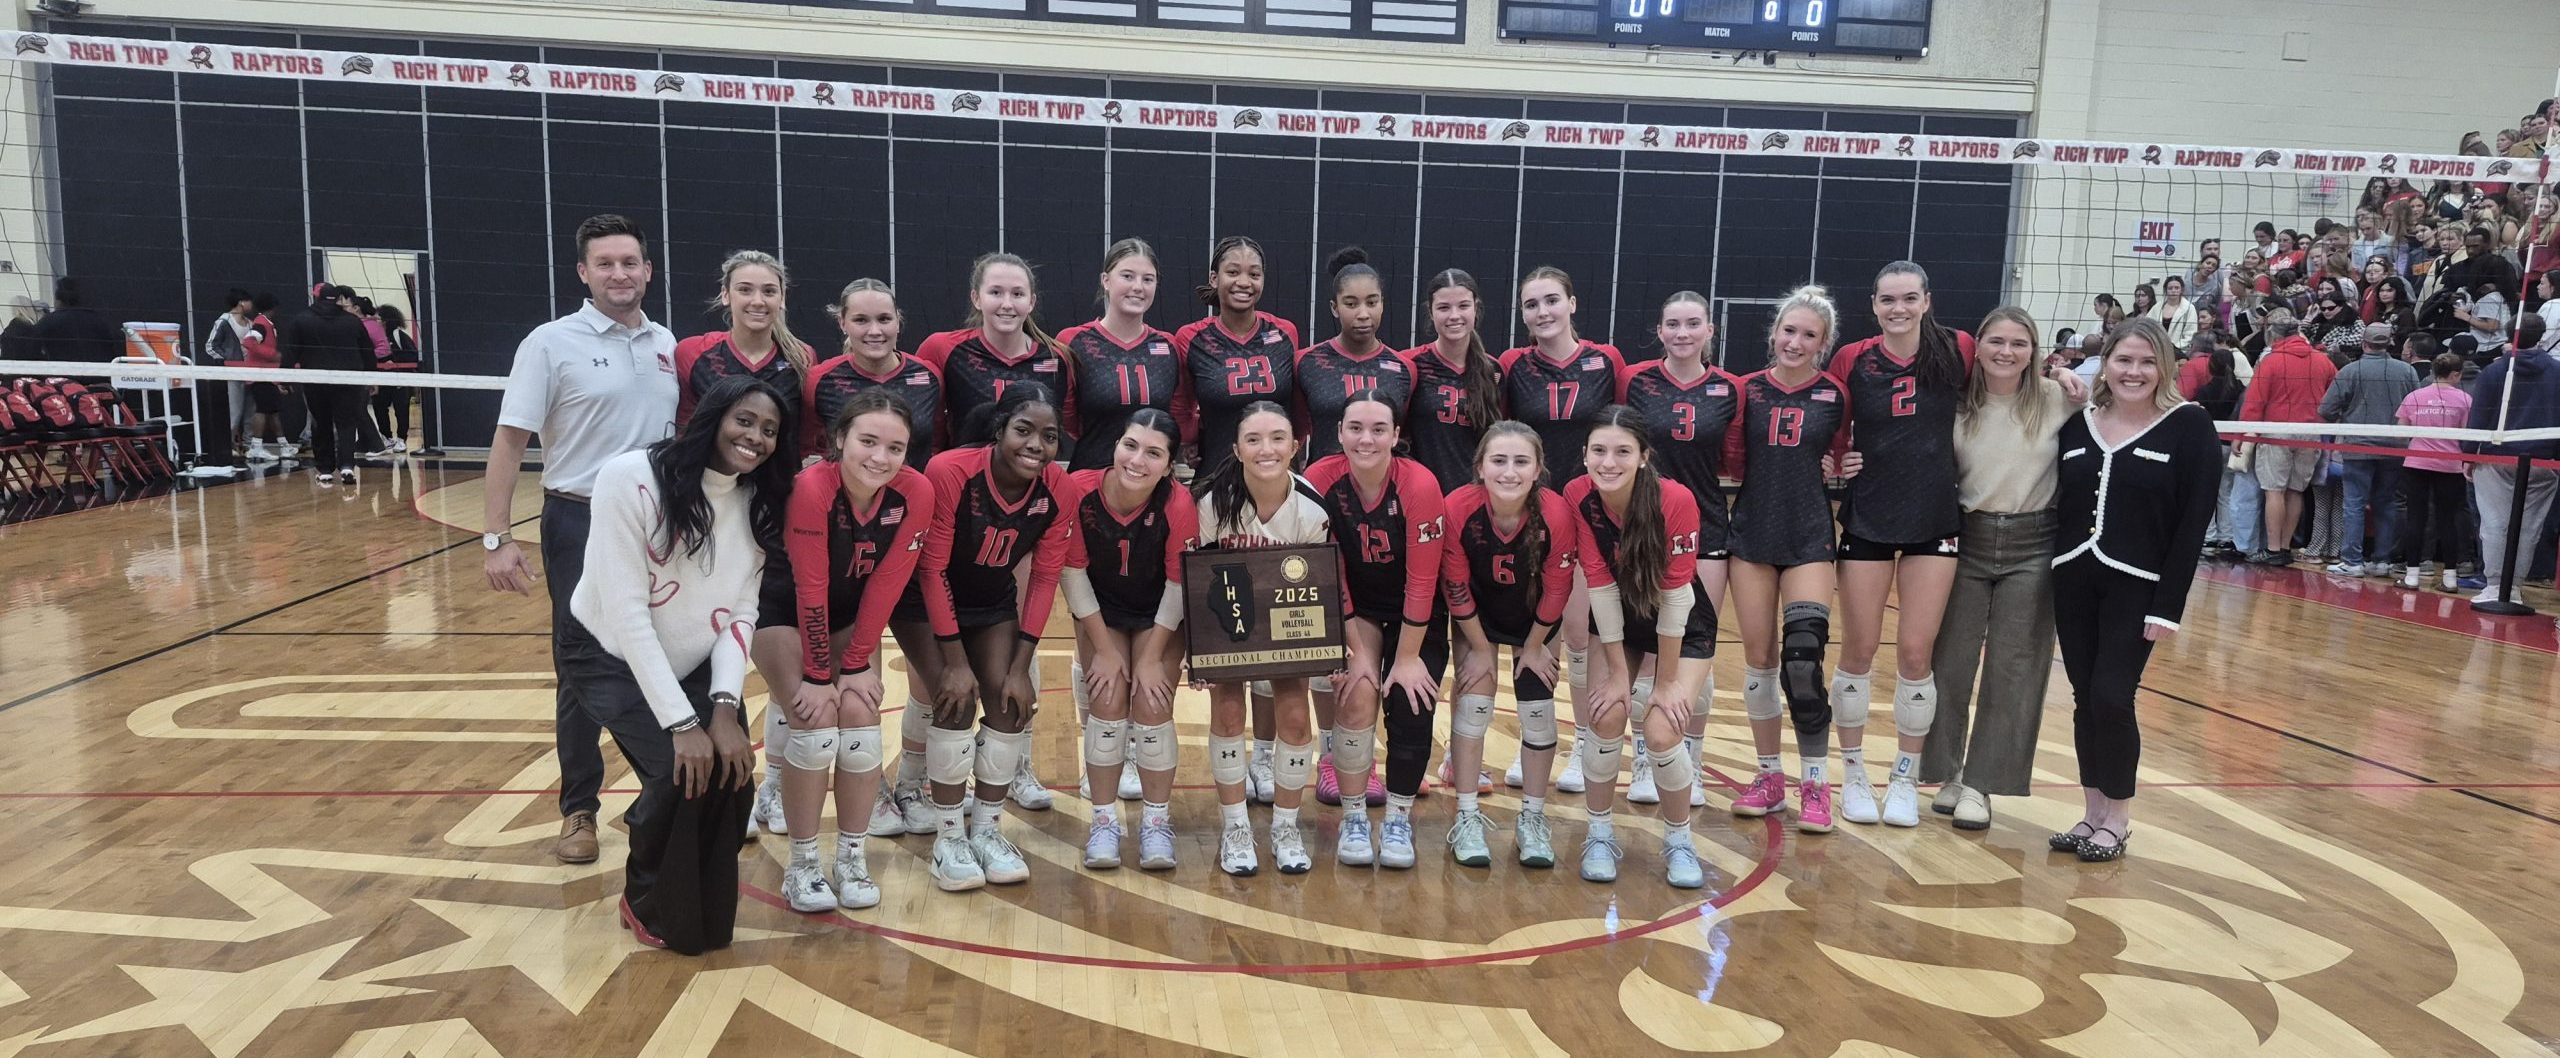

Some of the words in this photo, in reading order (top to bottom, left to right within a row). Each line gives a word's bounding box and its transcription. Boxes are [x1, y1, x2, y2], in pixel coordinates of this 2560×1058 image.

[1614, 22, 1643, 34] POINTS
[1704, 26, 1731, 38] MATCH
[1791, 31, 1820, 42] POINTS
[70, 42, 115, 62] RICH
[123, 45, 168, 65] TWP
[233, 53, 323, 75] RAPTORS
[393, 62, 439, 80] RICH
[444, 64, 488, 82] TWP
[550, 71, 636, 91] RAPTORS
[705, 81, 745, 99] RICH
[753, 84, 794, 102] TWP
[853, 89, 934, 110] RAPTORS
[1000, 99, 1038, 117] RICH
[1045, 101, 1084, 120] TWP
[1140, 108, 1217, 127] RAPTORS
[1279, 114, 1316, 132] RICH
[1323, 117, 1360, 133] TWP
[1413, 121, 1486, 139] RAPTORS
[1546, 127, 1582, 143] RICH
[1589, 128, 1624, 144] TWP
[1675, 132, 1748, 150] RAPTORS
[1804, 137, 1839, 153] RICH
[1845, 138, 1880, 154] TWP
[1929, 141, 1999, 158] RAPTORS
[2054, 146, 2088, 162] RICH
[2094, 148, 2128, 163] TWP
[2176, 150, 2243, 167] RAPTORS
[2295, 155, 2327, 170] RICH
[2332, 156, 2366, 171] TWP
[2409, 160, 2474, 176] RAPTORS
[2140, 221, 2174, 241] EXIT
[1115, 363, 1151, 405] 11
[1224, 355, 1277, 397] 23
[1547, 381, 1580, 421] 17
[1891, 376, 1917, 418] 2
[1671, 402, 1696, 442] 3
[1768, 406, 1805, 447] 13
[974, 525, 1020, 568] 10
[1117, 539, 1130, 577] 1
[1356, 522, 1395, 564] 12
[1492, 553, 1516, 585] 6
[1274, 587, 1319, 603] 2025
[1281, 619, 1314, 629] VOLLEYBALL
[1289, 609, 1305, 618] GIRLS
[1286, 630, 1301, 638] CLASS
[1199, 653, 1263, 666] SECTIONAL
[1271, 648, 1338, 661] CHAMPIONS
